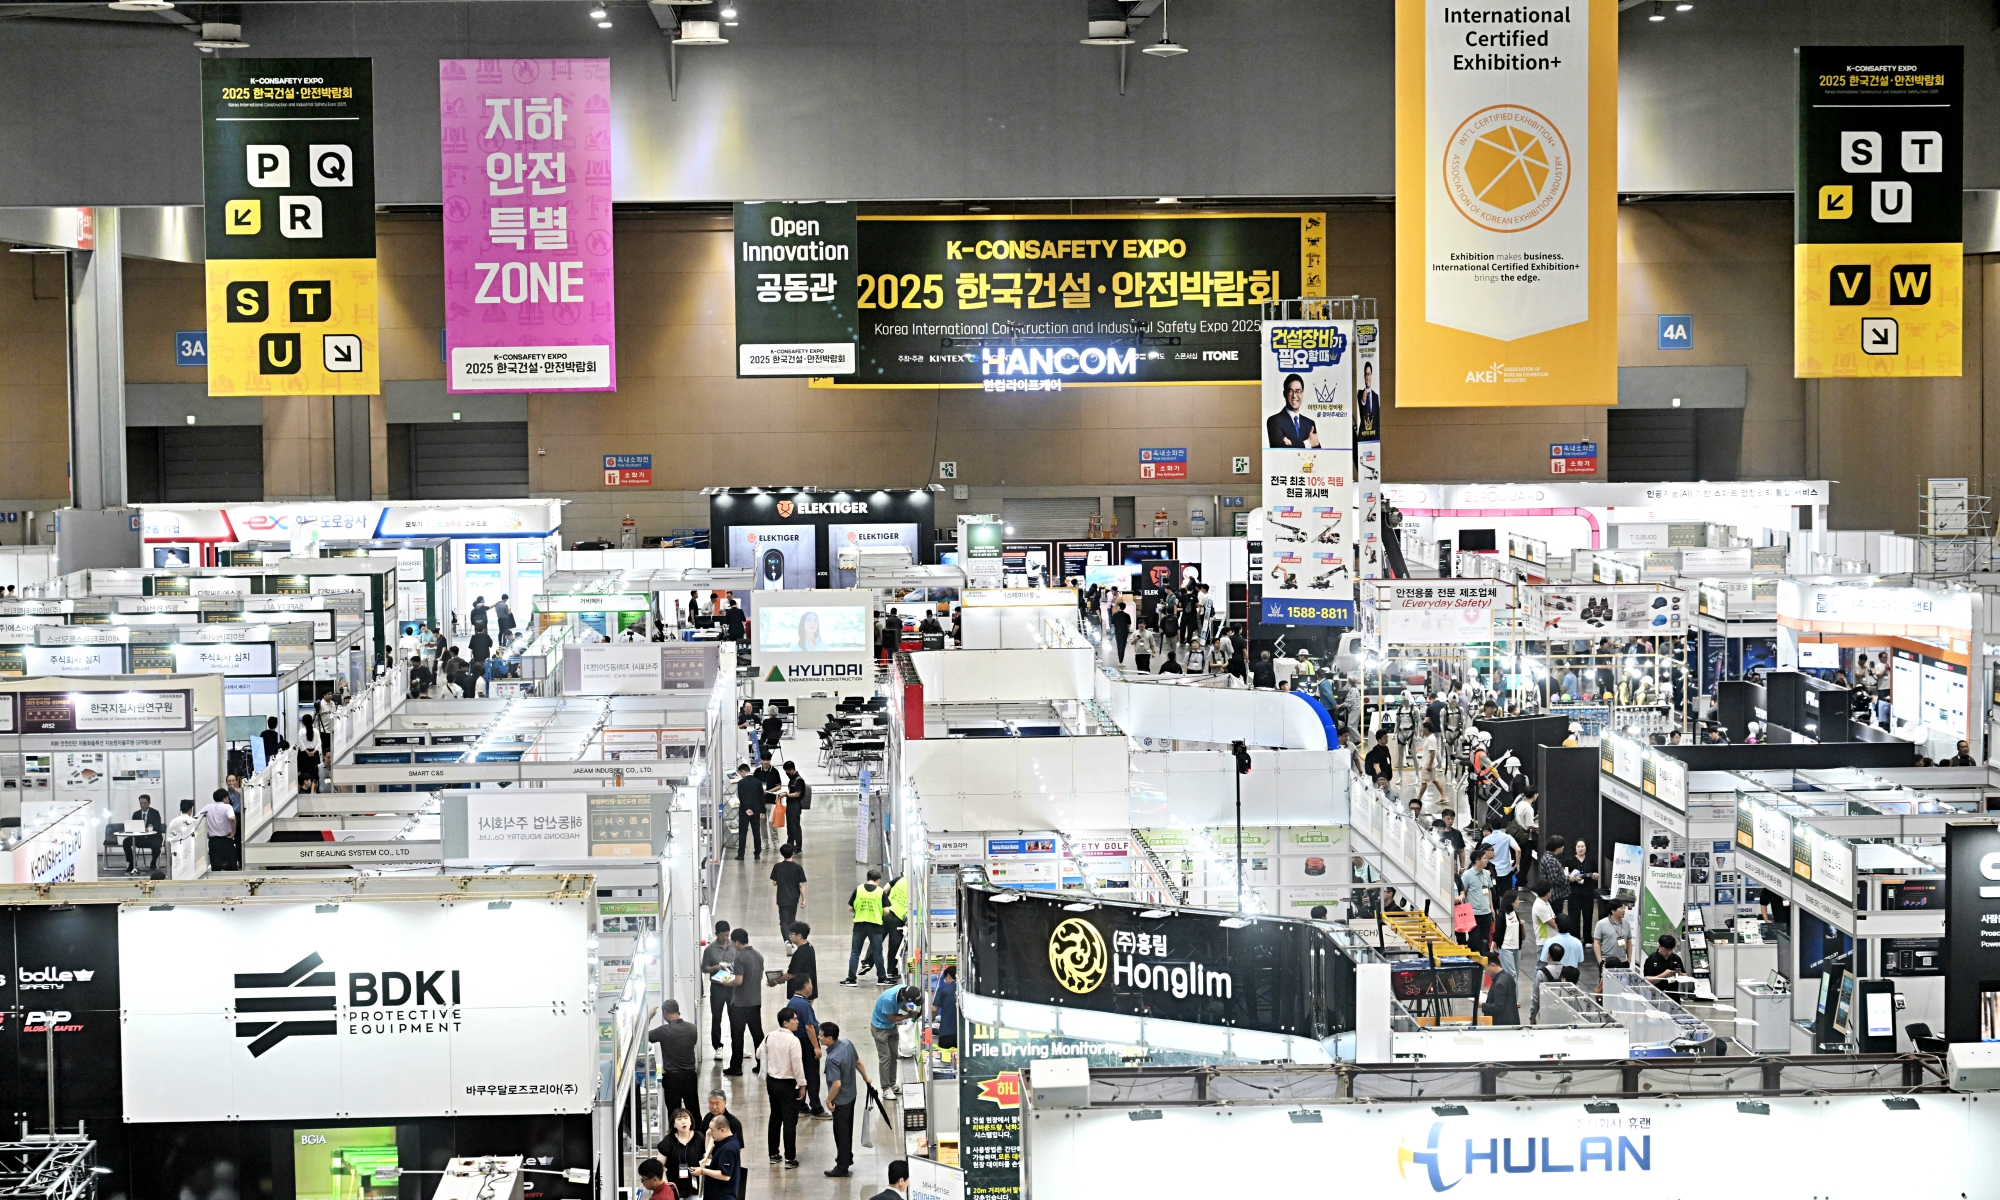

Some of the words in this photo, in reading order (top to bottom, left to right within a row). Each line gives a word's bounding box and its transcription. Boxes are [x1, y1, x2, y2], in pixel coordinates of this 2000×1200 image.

[1444, 6, 1570, 24] International
[1465, 30, 1548, 47] Certified
[1453, 54, 1562, 71] Exhibition+
[1819, 76, 1846, 86] 2025
[1849, 74, 1944, 86] 한국건설·안전박람회
[222, 87, 250, 100] 2025
[253, 87, 353, 99] 한국건설·안전박람회
[484, 97, 568, 140] 지하
[1474, 112, 1513, 130] CERTIFIED
[1514, 114, 1556, 148] EXHIBITION+
[1851, 138, 1873, 166] S
[1910, 139, 1934, 165] T
[258, 153, 278, 179] P
[317, 151, 346, 182] Q
[486, 152, 566, 196] 안전
[1452, 154, 1472, 207] ASSOCIATION
[1470, 204, 1482, 214] OF
[1480, 211, 1513, 224] KOREAN
[1514, 194, 1554, 224] EXHIBITION
[1550, 156, 1563, 196] INDUSTRY
[1880, 189, 1904, 215] U
[290, 204, 311, 230] R
[488, 206, 568, 250] 특별
[770, 216, 820, 238] Open
[742, 241, 849, 262] Innovation
[946, 239, 1118, 260] K-CONSAFETY
[1122, 239, 1187, 258] EXPO
[1450, 252, 1494, 260] Exhibition
[1496, 252, 1522, 260] makes
[1524, 252, 1564, 260] business.
[1432, 262, 1490, 271] International
[1492, 262, 1529, 271] Certified
[1531, 262, 1580, 271] Exhibition+
[474, 261, 584, 304] ZONE
[1474, 273, 1499, 283] brings
[1500, 273, 1515, 282] the
[1516, 273, 1540, 283] edge.
[1837, 272, 1864, 298] V
[1893, 272, 1928, 298] W
[756, 273, 837, 302] 공동관
[857, 274, 944, 309] 2025
[956, 270, 1280, 310] 한국건설·안전박람회
[236, 288, 260, 316] S
[298, 288, 322, 316] T
[874, 322, 908, 336] Korea
[912, 322, 988, 336] International
[1072, 322, 1094, 334] and
[1157, 320, 1197, 334] Safety
[1200, 320, 1228, 334] Expo
[1232, 320, 1262, 332] 2025
[1663, 324, 1688, 340] 4A
[1272, 328, 1342, 349] 건설장비가
[181, 340, 205, 357] 3A
[268, 341, 292, 368] U
[1202, 350, 1238, 361] ITONE
[750, 355, 770, 364] 2025
[930, 355, 965, 363] KINTEX
[982, 348, 1137, 375] HANCOM
[466, 363, 494, 374] 2025
[496, 361, 597, 374] 한국건설·안전박람회
[1465, 362, 1498, 383] AKEI
[983, 378, 1062, 392] 한컴라이프케어
[1270, 476, 1288, 486] 전국
[1290, 476, 1306, 486] 최초
[1307, 477, 1326, 486] 10%
[1328, 477, 1344, 486] 적립
[1286, 488, 1302, 498] 현금
[1304, 488, 1329, 498] 캐시백
[798, 502, 868, 515] ELEKTIGER
[758, 534, 800, 542] ELEKTIGER
[858, 532, 900, 541] ELEKTIGER
[1396, 587, 1434, 598] 안전용품
[1437, 587, 1456, 598] 전문
[1460, 587, 1497, 598] 제조업체
[1402, 598, 1453, 609] (Everyday
[1455, 598, 1492, 608] Safety)
[1288, 606, 1348, 620] 1588-8811
[50, 656, 81, 664] 주식회사
[85, 655, 100, 664] 심지
[200, 653, 231, 662] 주식회사
[234, 653, 250, 662] 심지
[789, 664, 862, 676] HYUNDAI
[90, 702, 173, 714] 한국지질자원연구원
[316, 850, 346, 858] SEALING
[378, 850, 394, 858] CO.,
[1104, 842, 1129, 850] GOLF
[1651, 871, 1682, 879] SmartRock
[1113, 930, 1167, 957] (주)홍림
[19, 966, 73, 982] bolle
[1113, 954, 1232, 998] Honglim
[349, 970, 461, 1007] BDKI
[350, 1009, 462, 1022] PROTECTIVE
[350, 1022, 462, 1034] EQUIPMENT
[972, 1043, 998, 1057] Pile
[1001, 1042, 1049, 1059] Drving
[466, 1084, 578, 1096] 바쿠우달로즈코리아(주)
[1627, 1117, 1650, 1129] 휴랜
[301, 1134, 326, 1144] BGIA
[1465, 1135, 1650, 1174] HULAN
